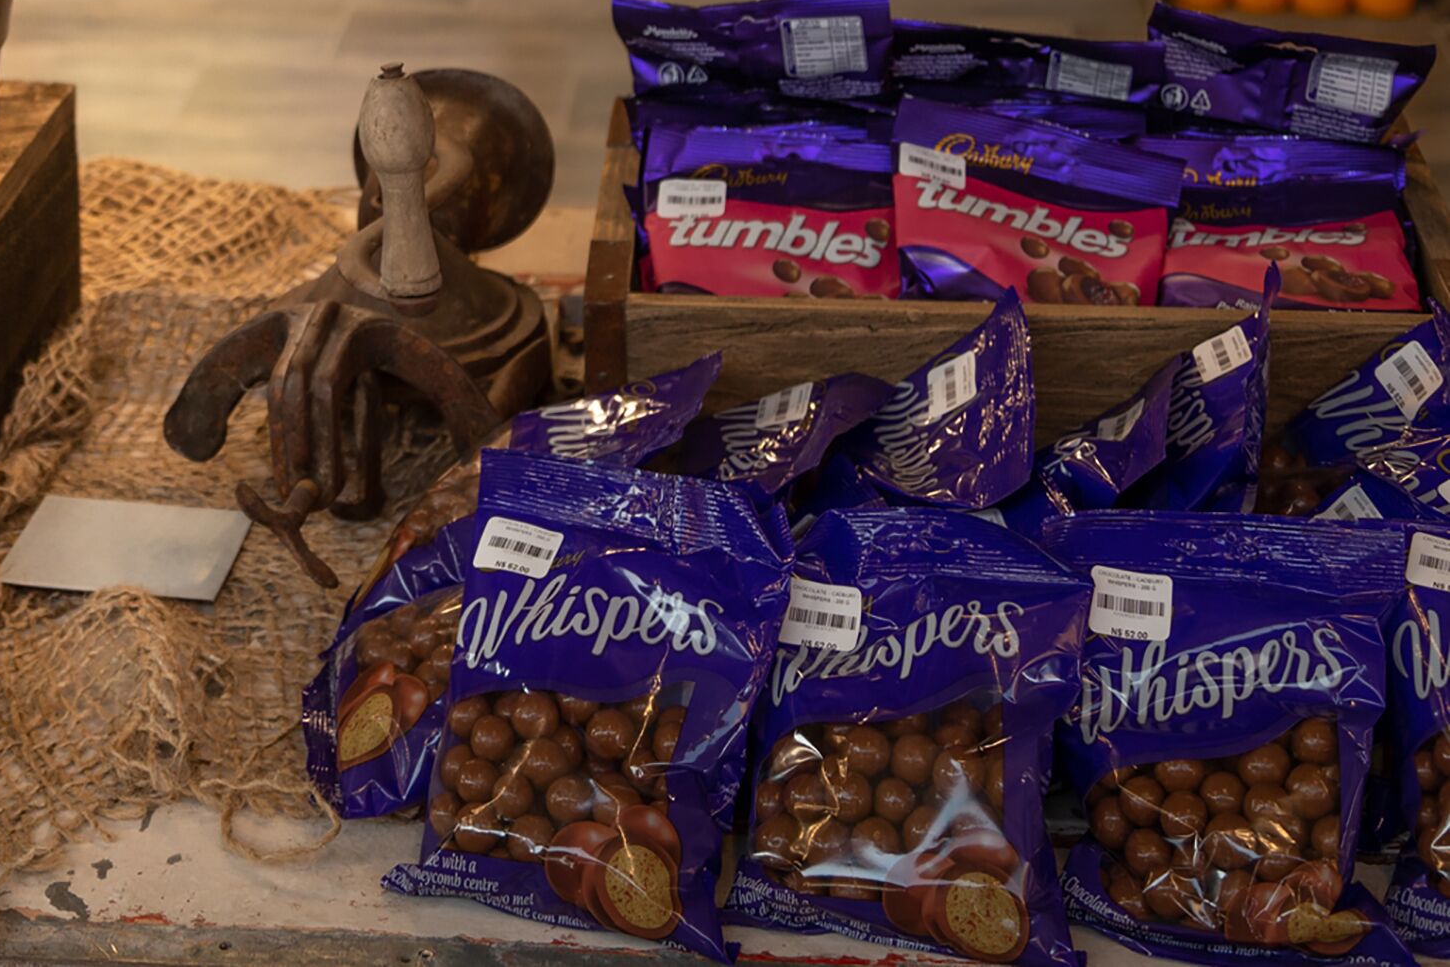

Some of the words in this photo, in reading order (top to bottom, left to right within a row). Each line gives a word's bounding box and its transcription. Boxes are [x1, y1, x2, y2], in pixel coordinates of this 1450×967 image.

[456, 573, 725, 670] Whispers
[1074, 624, 1342, 745] Whispers
[441, 852, 467, 872] with
[469, 861, 477, 874] a
[464, 877, 500, 892] centre
